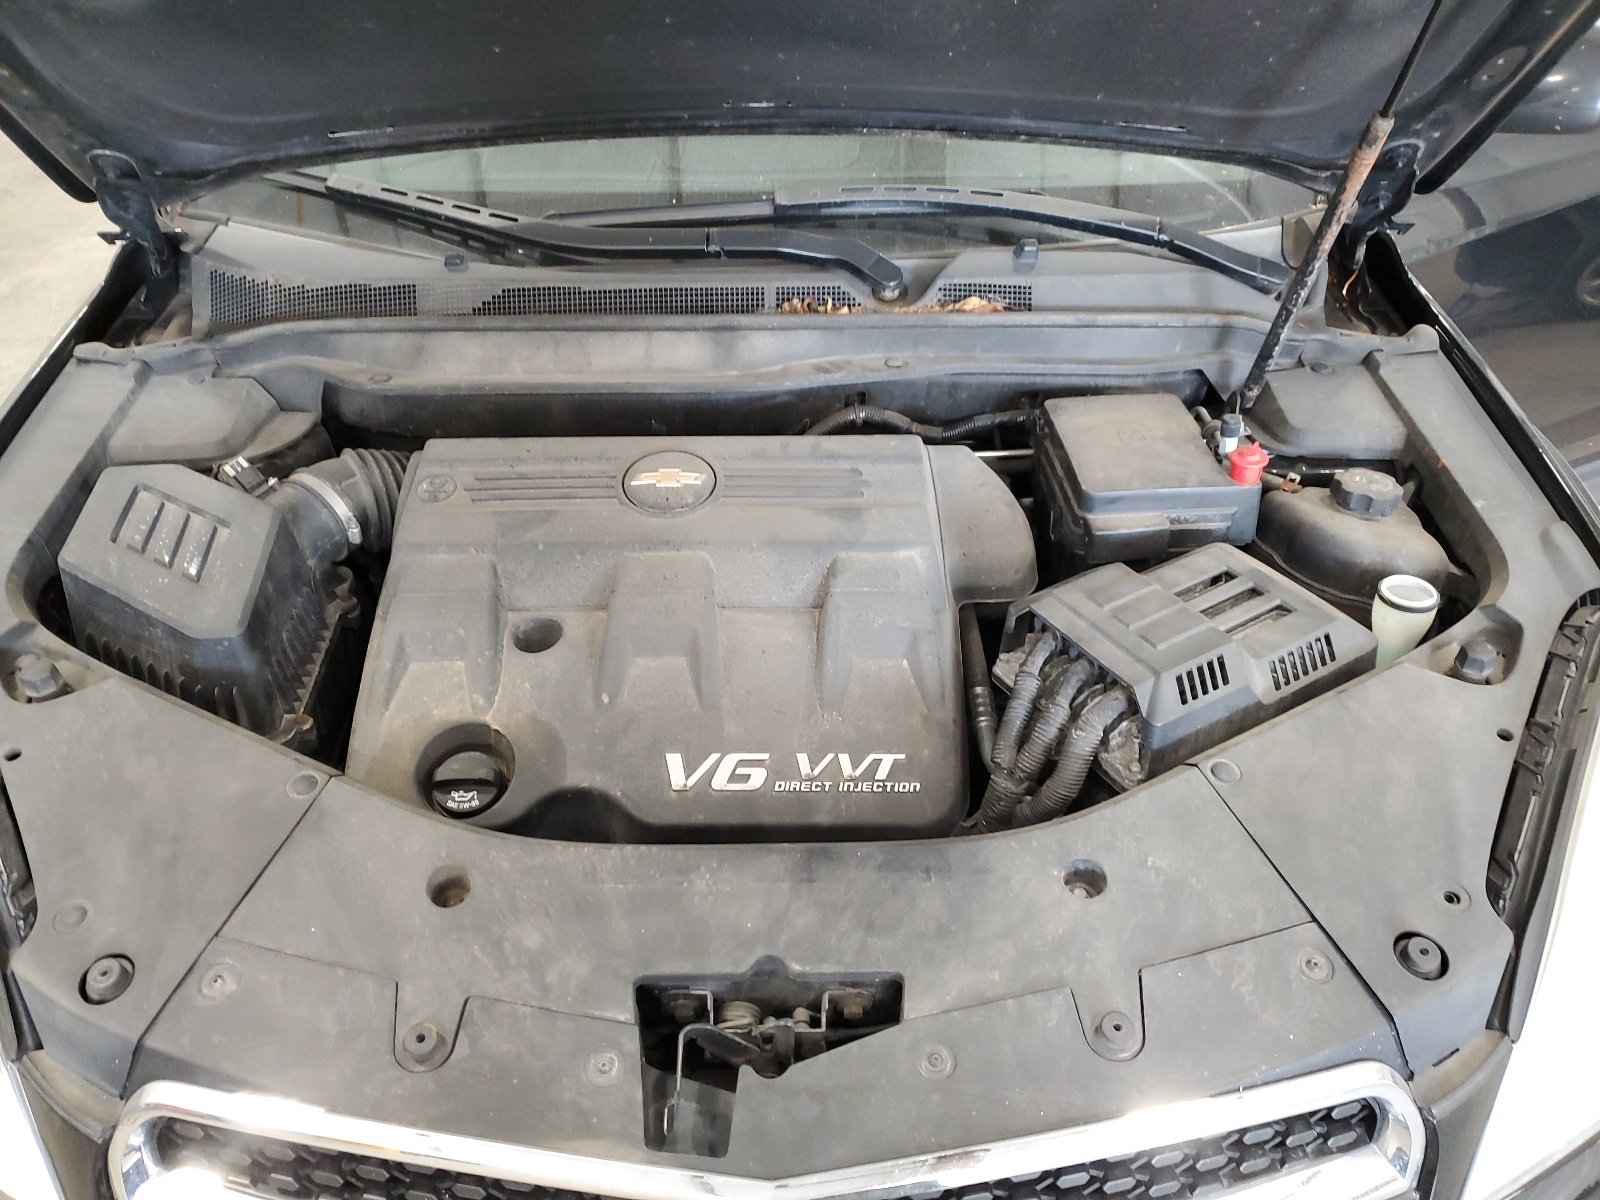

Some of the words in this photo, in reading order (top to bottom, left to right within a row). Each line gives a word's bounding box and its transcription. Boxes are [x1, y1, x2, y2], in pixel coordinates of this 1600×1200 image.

[665, 752, 771, 791] V6
[795, 752, 906, 781] VVT
[774, 781, 833, 793] DIRECT
[838, 781, 920, 793] INJECTION
